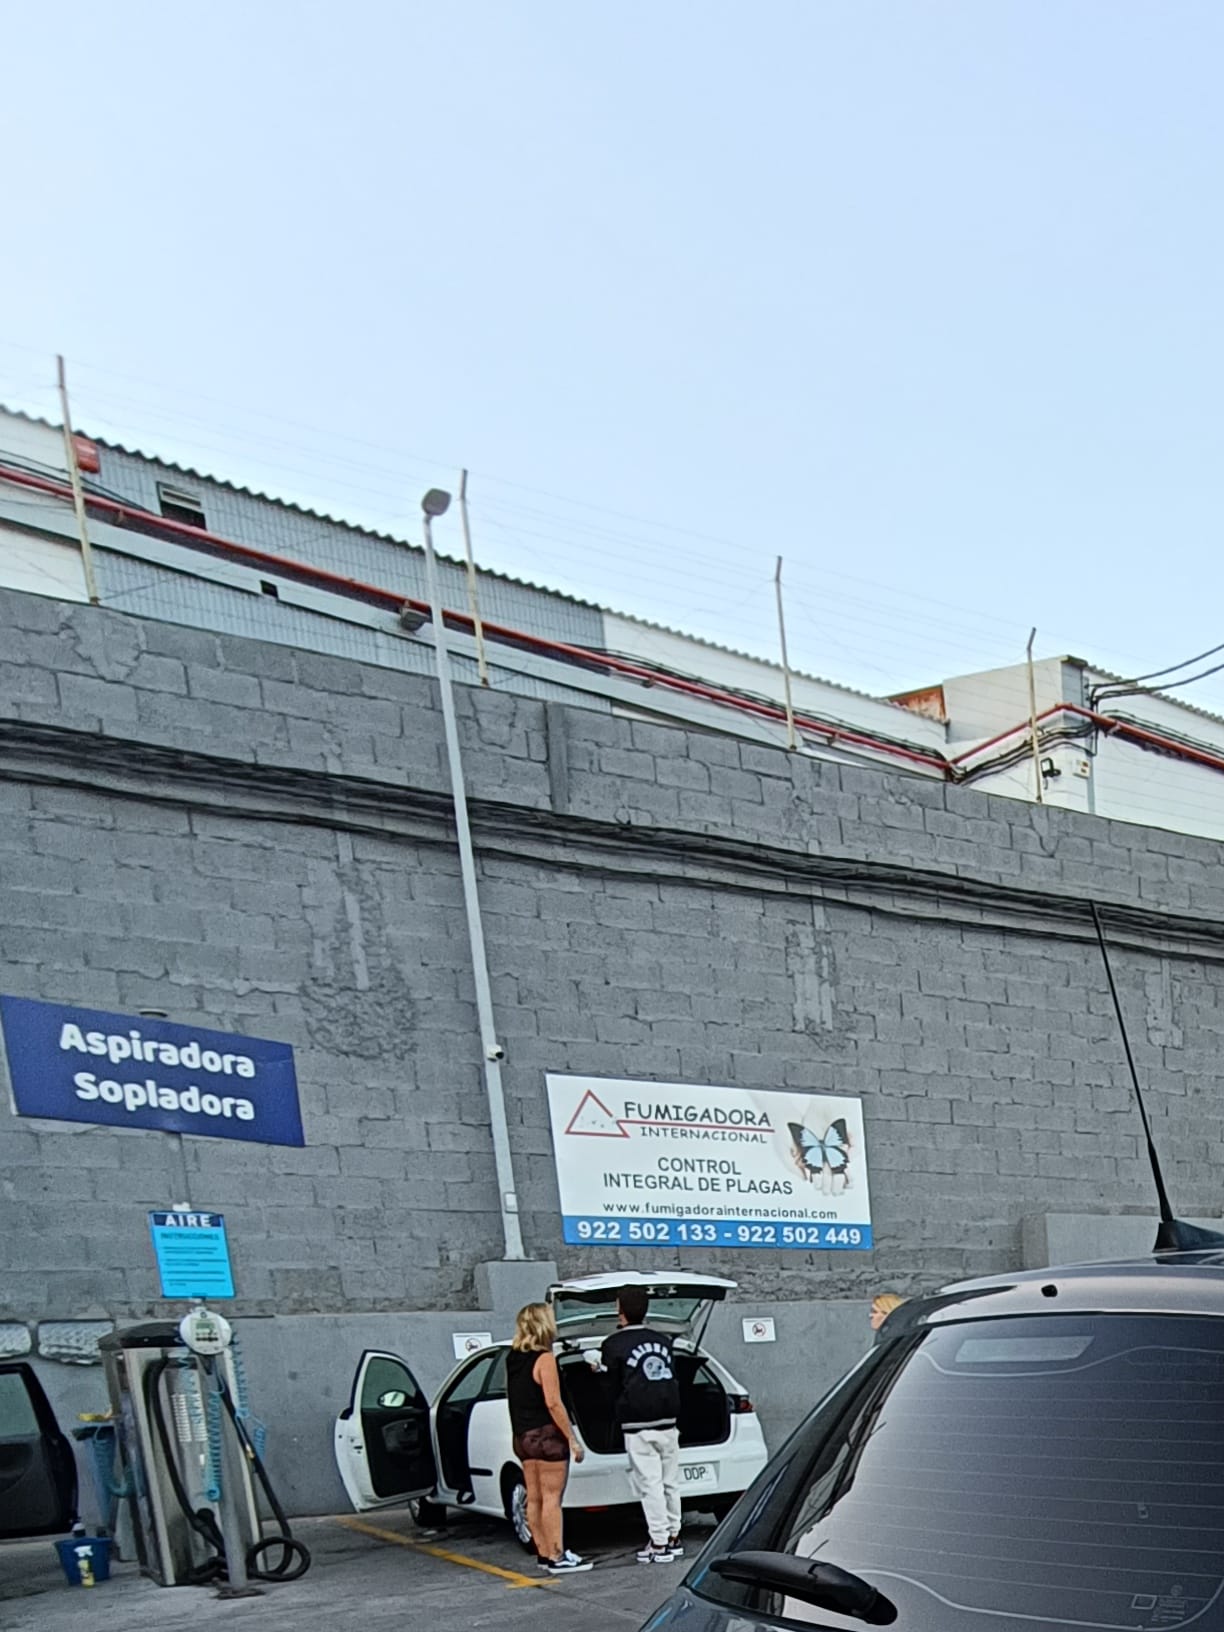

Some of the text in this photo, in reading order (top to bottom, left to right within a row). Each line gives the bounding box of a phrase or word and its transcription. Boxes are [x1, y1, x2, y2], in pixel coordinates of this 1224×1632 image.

[59, 1022, 256, 1079] Aspiradora
[74, 1071, 256, 1121] Sopladora
[624, 1101, 772, 1127] FUMIGADORA
[640, 1126, 767, 1144] INTERNACIONAL
[657, 1156, 742, 1176] CONTROL
[603, 1172, 793, 1195] INTEGRAL DE PLAGAS
[165, 1214, 212, 1228] AIRE
[603, 1201, 838, 1220] www.fumigadorainternacional.com
[577, 1221, 622, 1240] 922
[629, 1222, 670, 1241] 502
[677, 1223, 717, 1242] 133
[737, 1225, 776, 1243] 922
[782, 1227, 820, 1244] 502
[825, 1227, 861, 1245] 449
